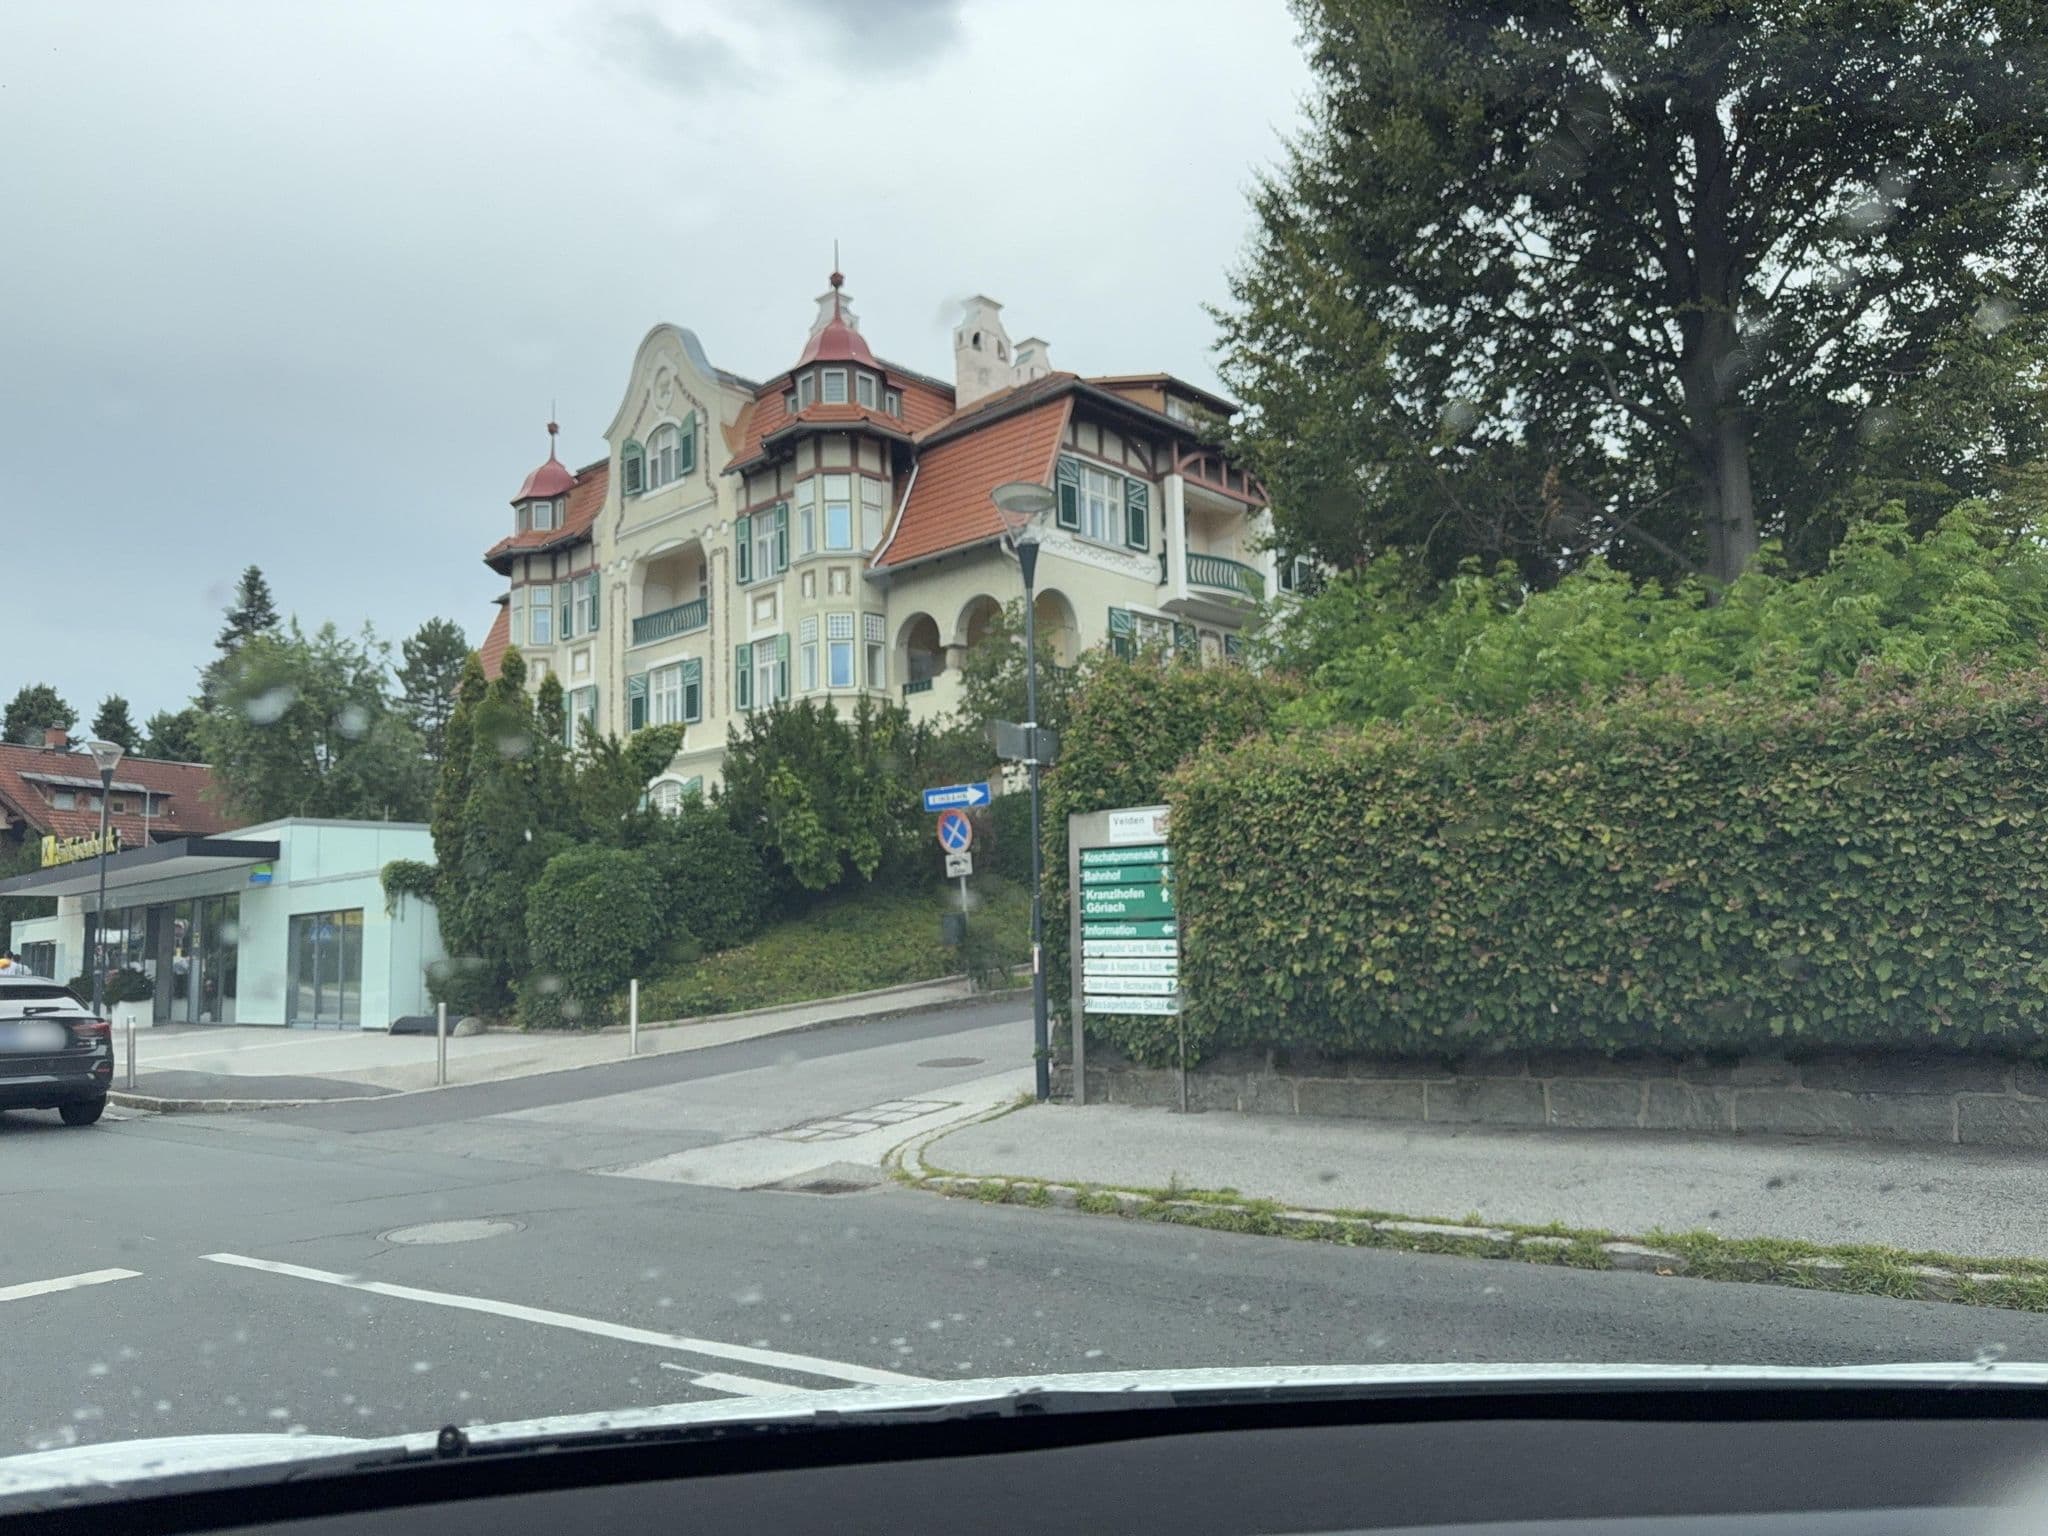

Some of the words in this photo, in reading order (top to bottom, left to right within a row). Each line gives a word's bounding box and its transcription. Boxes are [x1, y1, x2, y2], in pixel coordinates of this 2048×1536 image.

[1112, 816, 1145, 825] Velden
[1084, 869, 1121, 882] Bahnhof
[1086, 888, 1145, 901] Kranzlhofen
[1086, 902, 1126, 913] Göriach
[1085, 923, 1137, 936] Information
